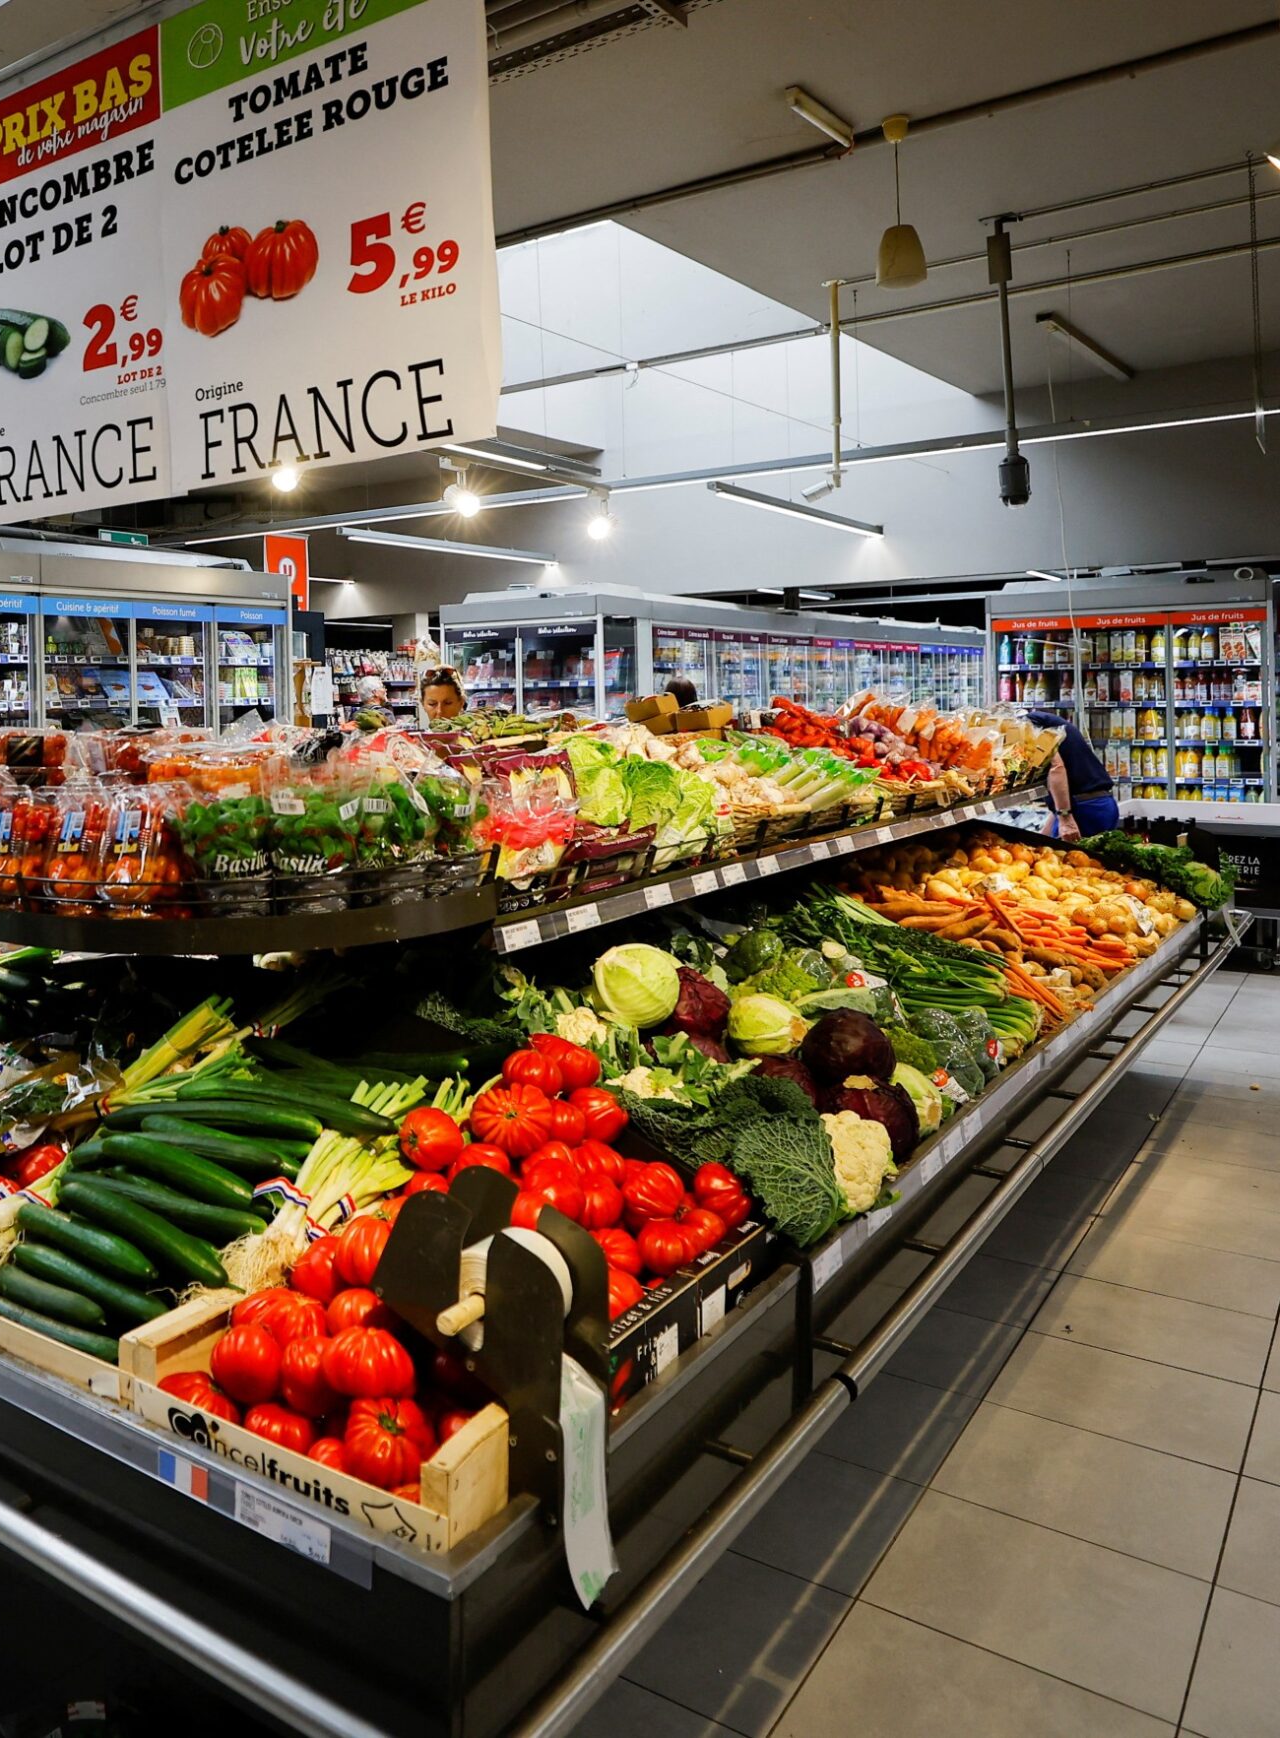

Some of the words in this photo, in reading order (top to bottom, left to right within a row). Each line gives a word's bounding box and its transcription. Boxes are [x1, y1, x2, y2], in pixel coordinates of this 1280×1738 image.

[240, 17, 316, 65] Votre
[73, 53, 153, 125] BAS
[228, 42, 370, 124] TOMATE
[17, 147, 35, 167] de
[37, 125, 75, 161] votre
[77, 96, 144, 141] magasin
[174, 111, 314, 186] COTELEE
[322, 56, 450, 133] ROUGE
[52, 215, 94, 253] DE
[100, 205, 118, 236] 2
[400, 293, 419, 307] LE
[421, 282, 457, 304] KILO
[117, 372, 138, 385] LOT
[140, 367, 154, 380] DE
[156, 366, 163, 376] 2
[79, 388, 129, 406] Concombre
[129, 381, 148, 395] seul
[195, 379, 244, 403] Origine
[199, 358, 455, 480] FRANCE
[56, 601, 84, 613] Cuisine
[86, 603, 92, 613] &
[93, 603, 119, 616] apéritif
[152, 606, 176, 617] Poisson
[178, 608, 196, 618] fumé
[240, 610, 263, 621] Poisson
[1096, 616, 1110, 625] Jus
[1111, 616, 1122, 625] de
[1123, 615, 1146, 625] fruits
[1190, 613, 1205, 622] Jus
[1206, 612, 1217, 622] de
[1219, 611, 1245, 621] fruits
[1011, 620, 1025, 629] Jus
[1026, 621, 1037, 629] de
[1037, 620, 1058, 629] fruits
[215, 849, 269, 873] Basilic
[1247, 856, 1261, 865] LA
[637, 1302, 651, 1311] &
[648, 1287, 673, 1303] fils
